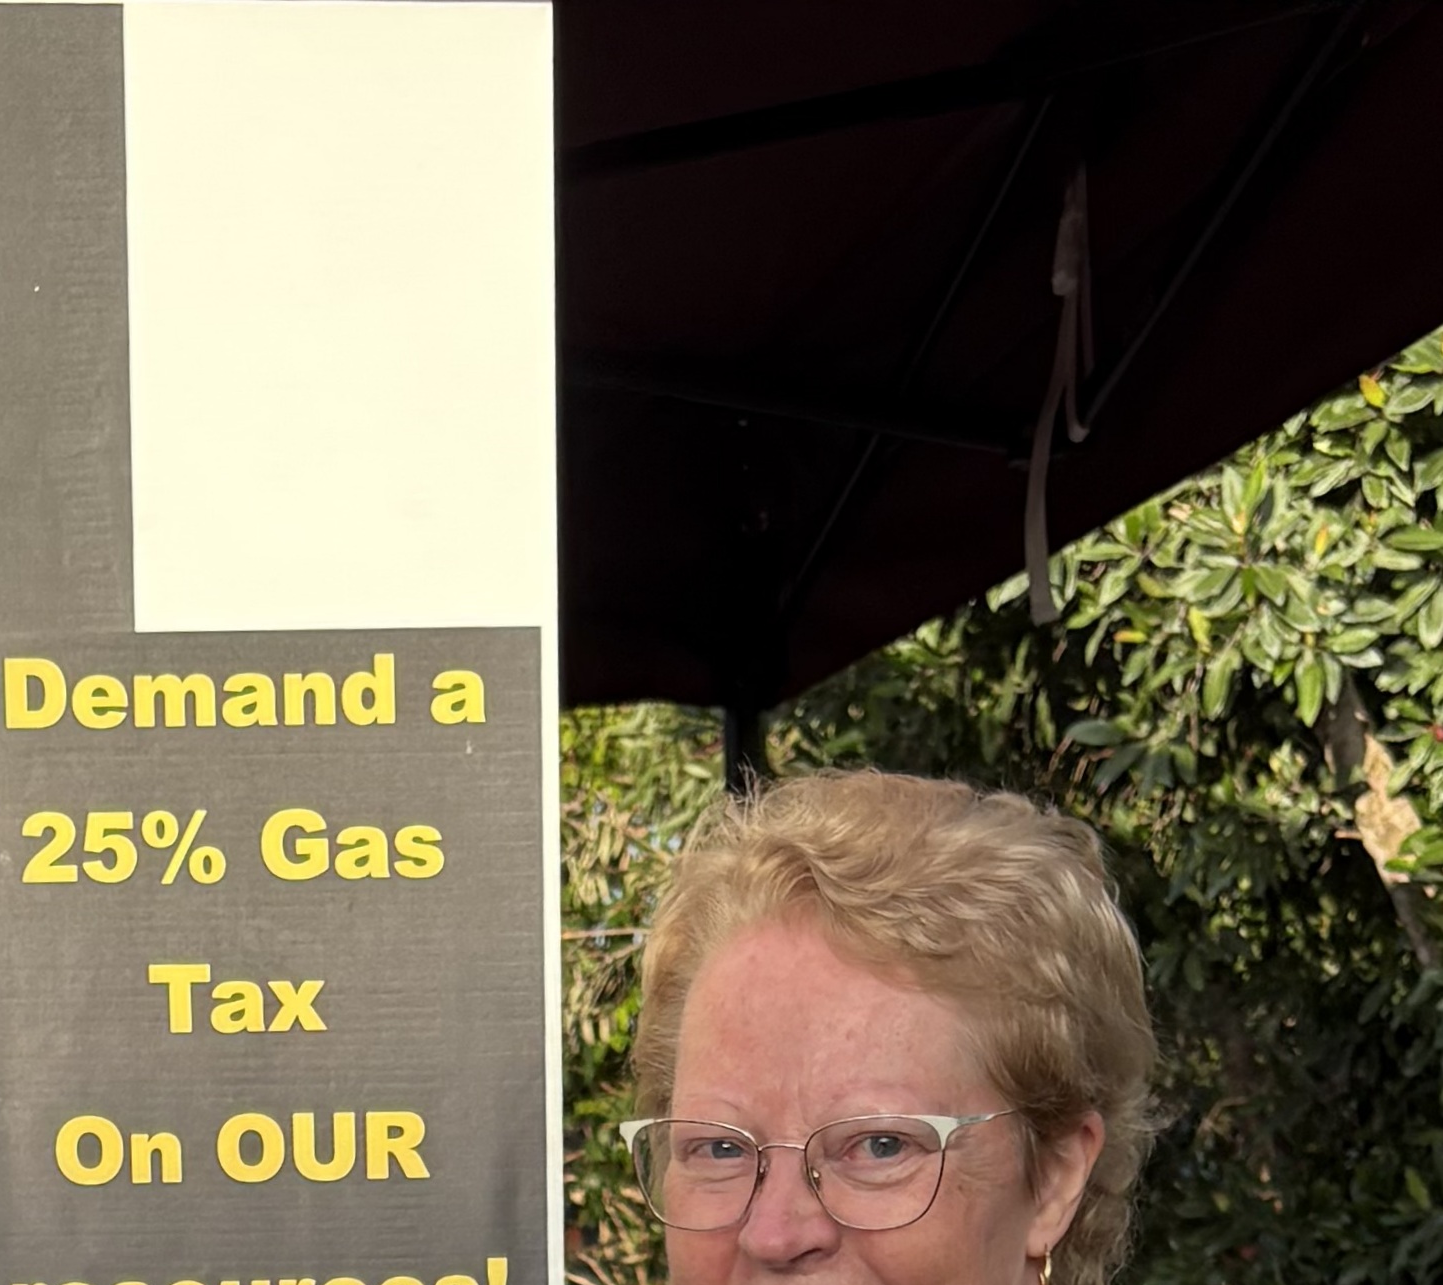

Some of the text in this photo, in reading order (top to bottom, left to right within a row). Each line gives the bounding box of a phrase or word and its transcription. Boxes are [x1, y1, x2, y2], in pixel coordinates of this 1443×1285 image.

[2, 653, 487, 730] Demand a
[21, 808, 446, 885] 25% Gas
[147, 963, 328, 1035] Tax
[54, 1110, 431, 1186] On OUR
